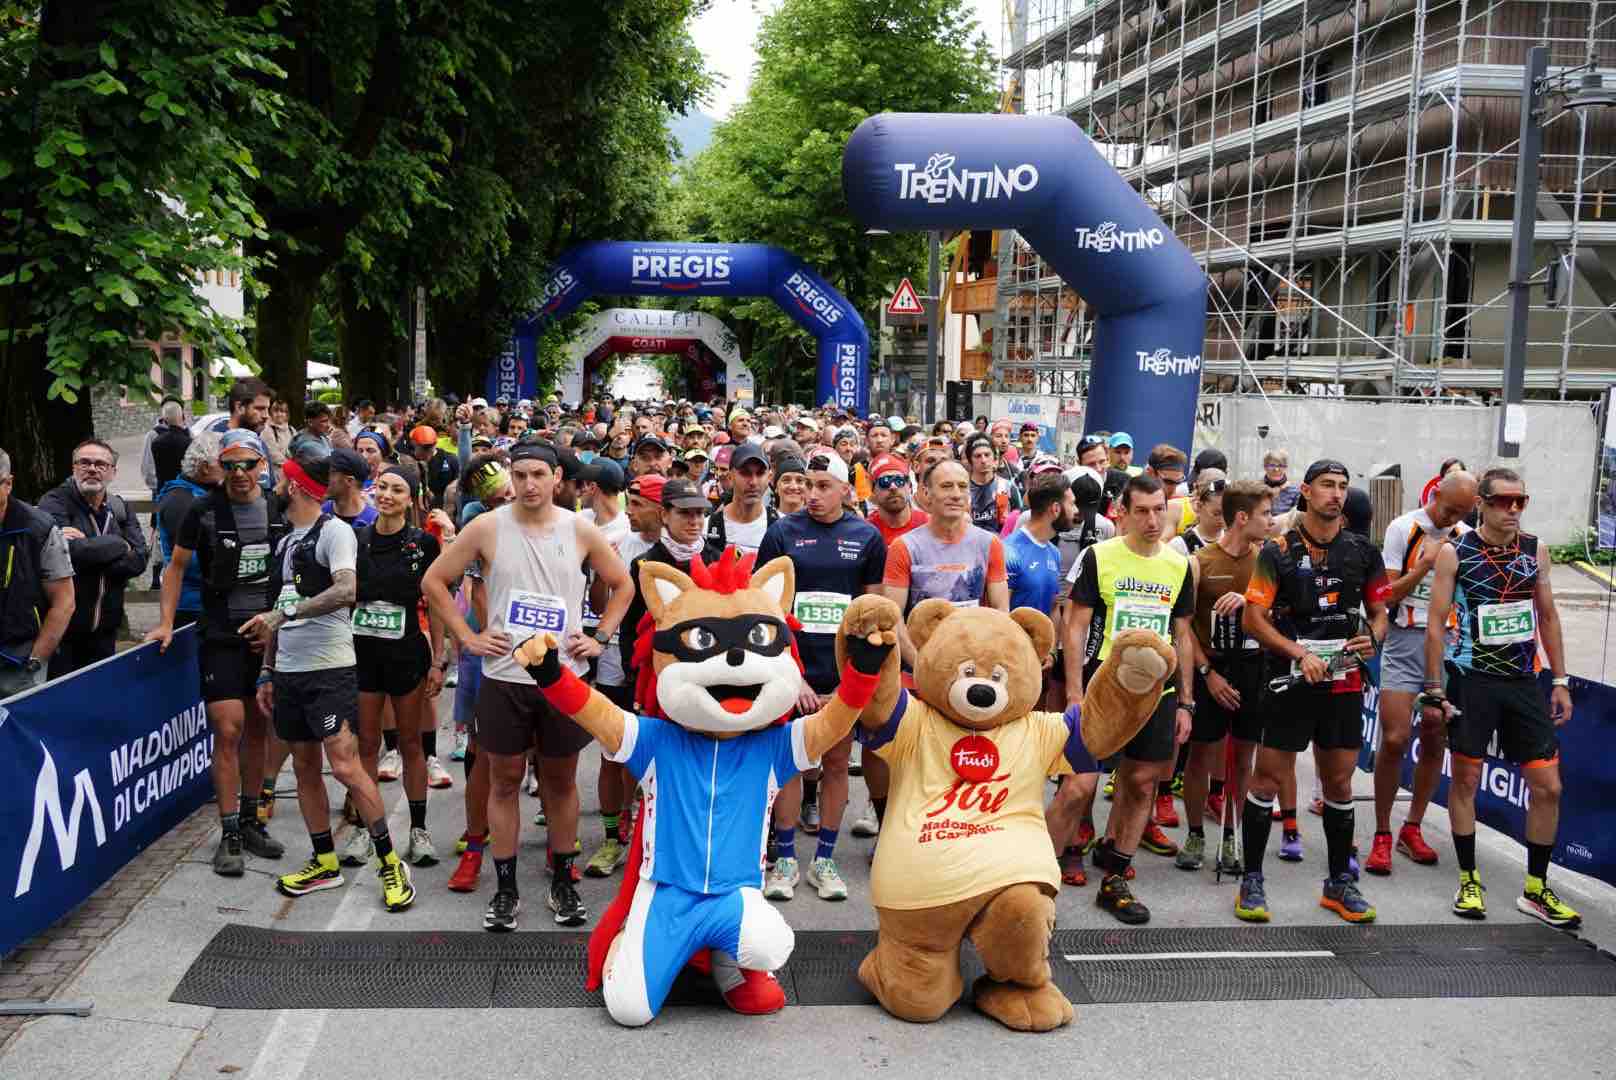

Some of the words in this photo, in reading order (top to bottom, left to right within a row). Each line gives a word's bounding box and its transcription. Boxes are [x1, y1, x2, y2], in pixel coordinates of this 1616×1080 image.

[894, 163, 1039, 203] TRENTINO
[1075, 227, 1164, 253] TRENTINO
[632, 255, 731, 278] PREGIS
[787, 272, 844, 323] PREGIS
[499, 350, 516, 404] PREGI
[841, 344, 856, 407] PREGIS
[1136, 351, 1201, 377] TRENTINO
[514, 606, 560, 628] 1553
[803, 607, 843, 622] 1338
[1487, 616, 1530, 635] 1254
[110, 700, 207, 786] MADONNA
[114, 786, 131, 832] DI
[134, 733, 215, 813] CAMPIGLI
